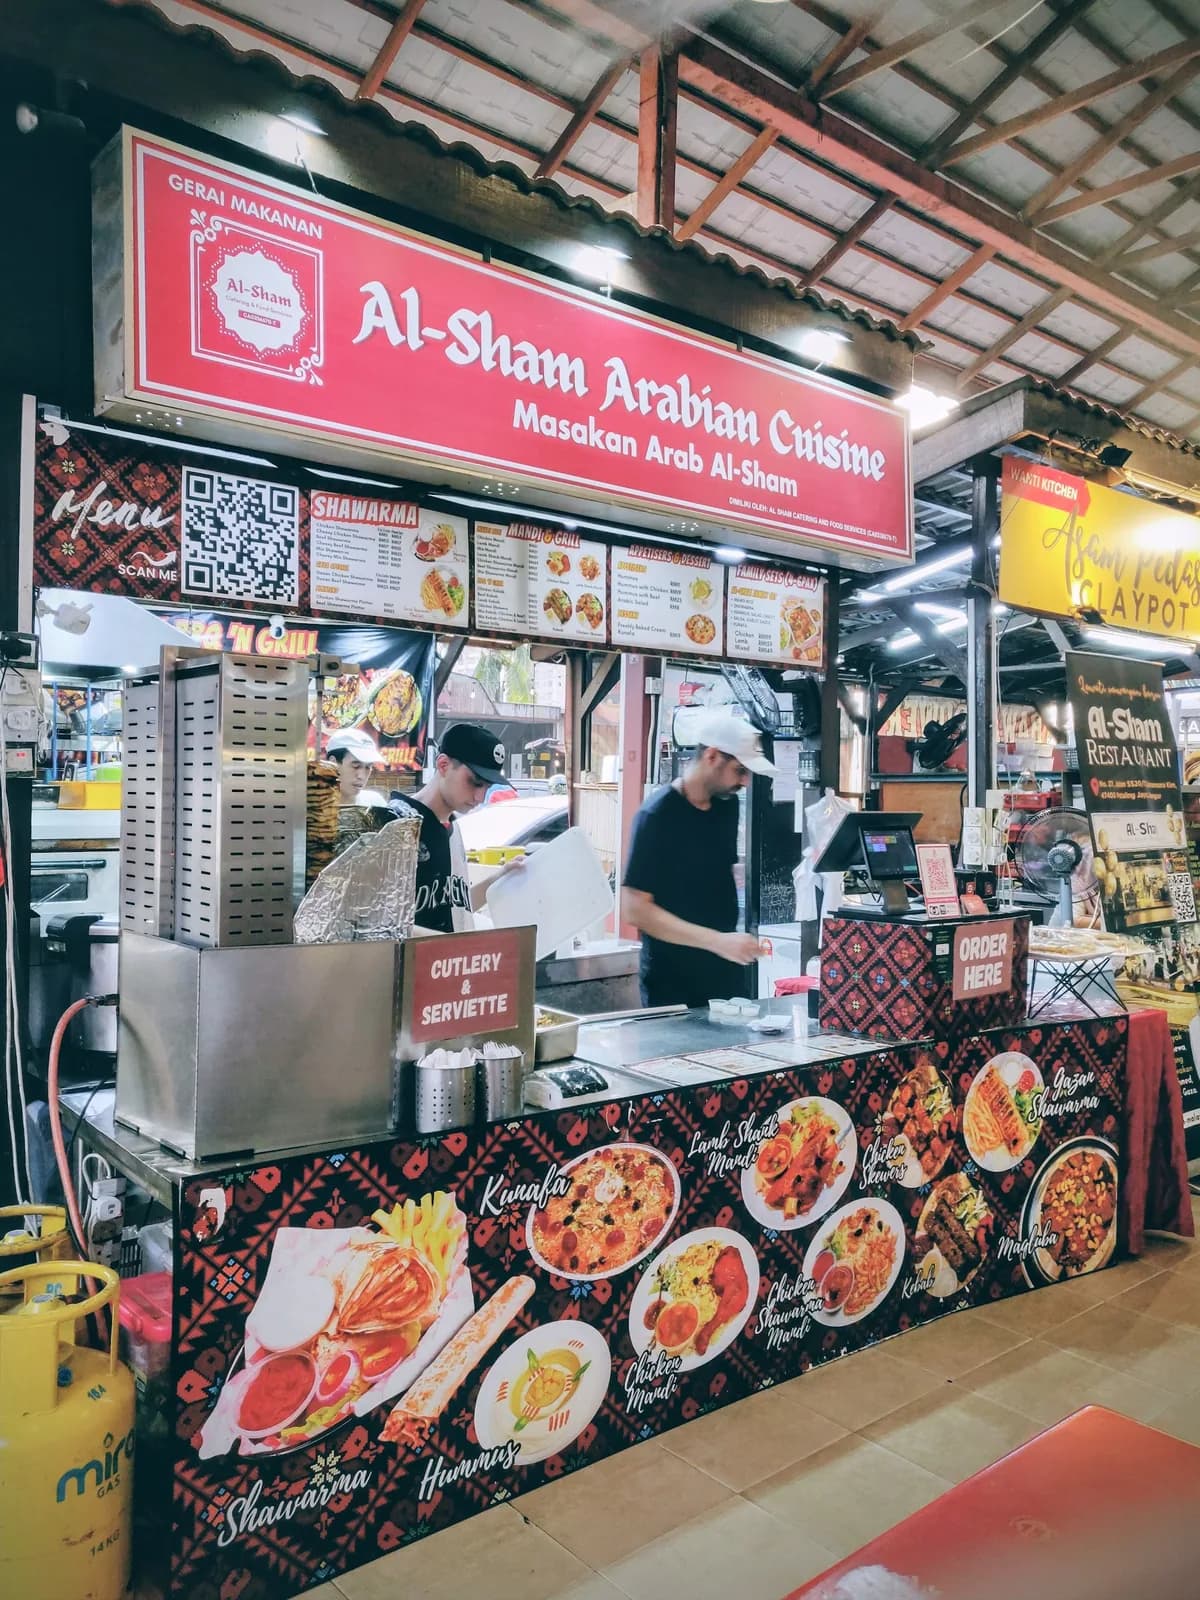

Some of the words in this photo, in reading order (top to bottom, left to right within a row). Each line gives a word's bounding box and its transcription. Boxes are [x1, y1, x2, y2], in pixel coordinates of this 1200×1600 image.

[168, 174, 225, 206] GERAI
[231, 196, 323, 239] MAKANAN
[226, 278, 292, 307] Al-Sham
[352, 281, 588, 397] Al-Sham
[600, 357, 760, 446] Arabian
[769, 413, 886, 481] Cuisine
[513, 400, 637, 457] Masakan
[646, 436, 704, 474] Arab
[710, 453, 797, 497] Al-Sham
[1011, 466, 1041, 488] WANTI
[1041, 478, 1078, 500] KITCHEN
[52, 481, 175, 539] Menu
[313, 496, 418, 526] SHAWARMA
[769, 506, 777, 515] AL
[777, 508, 792, 518] SHAM
[793, 512, 818, 524] CATERING
[818, 518, 829, 527] AND
[829, 520, 843, 530] FOOD
[844, 524, 867, 535] SERVICES
[508, 523, 542, 542] MANDI
[554, 531, 580, 547] GRILL
[1042, 503, 1128, 598] Asam
[118, 563, 156, 579] SCAN
[159, 568, 177, 581] ME
[628, 545, 672, 562] APPETISERS
[681, 553, 711, 569] DESSERT
[736, 565, 765, 580] FAMILY
[766, 569, 783, 583] SETS
[1080, 579, 1190, 631] CLAYPOT
[256, 630, 319, 658] GRILL
[1088, 706, 1163, 742] Al-Sham
[960, 933, 1007, 961] ORDER
[431, 952, 502, 979] CUTLERY
[963, 962, 1003, 991] HERE
[461, 979, 471, 995] &
[421, 993, 508, 1025] SERVIETTE
[1053, 1067, 1095, 1099] Gazan
[1028, 1087, 1100, 1123] Shawarma
[688, 1120, 730, 1158] Lamb
[734, 1112, 779, 1149] Shank
[707, 1144, 758, 1178] Mandi
[862, 1136, 906, 1169] Chicken
[480, 1164, 573, 1216] Kunafa
[859, 1164, 908, 1190] Skewers
[767, 1272, 816, 1310] Chicken
[901, 1264, 935, 1299] Kebab
[755, 1297, 825, 1335] Shawarma
[767, 1317, 811, 1350] Mandi
[625, 1350, 682, 1391] Chicken
[626, 1382, 678, 1413] Mandi
[97, 1474, 121, 1499] GAS
[418, 1439, 521, 1501] Hummus
[217, 1468, 372, 1547] Shawarma
